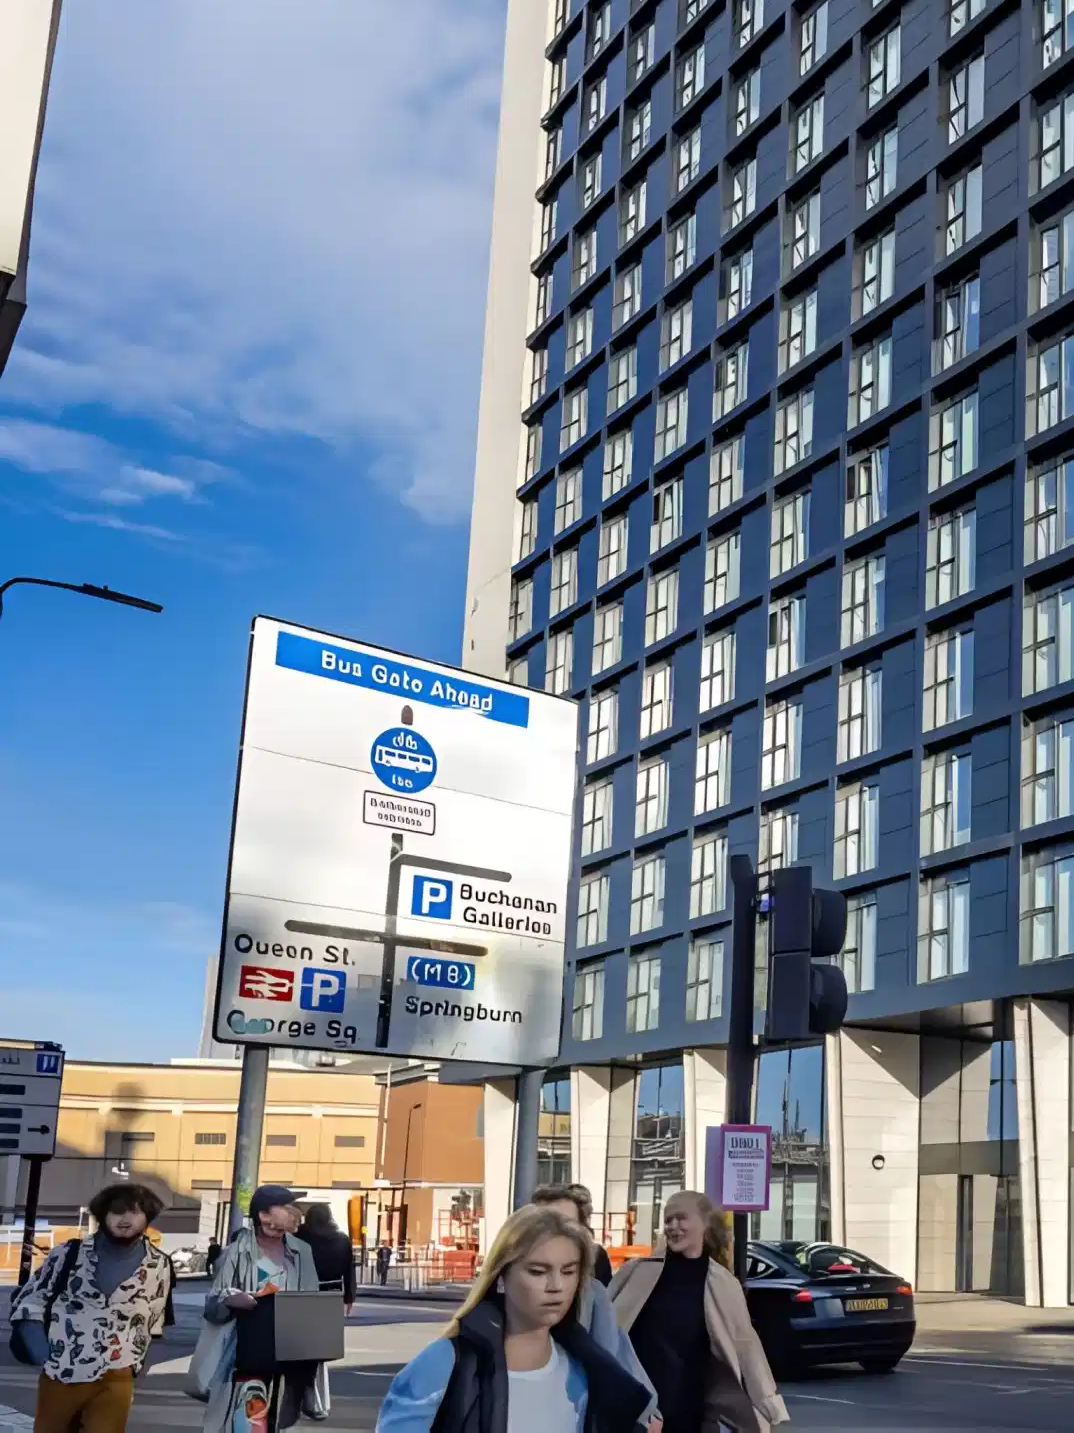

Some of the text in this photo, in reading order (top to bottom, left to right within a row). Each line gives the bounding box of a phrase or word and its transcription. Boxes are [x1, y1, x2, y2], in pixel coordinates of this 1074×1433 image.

[421, 881, 447, 914] P
[460, 883, 558, 914] Buchanan
[234, 933, 313, 961] Queen
[312, 973, 340, 1007] P
[405, 995, 523, 1024] Springburn
